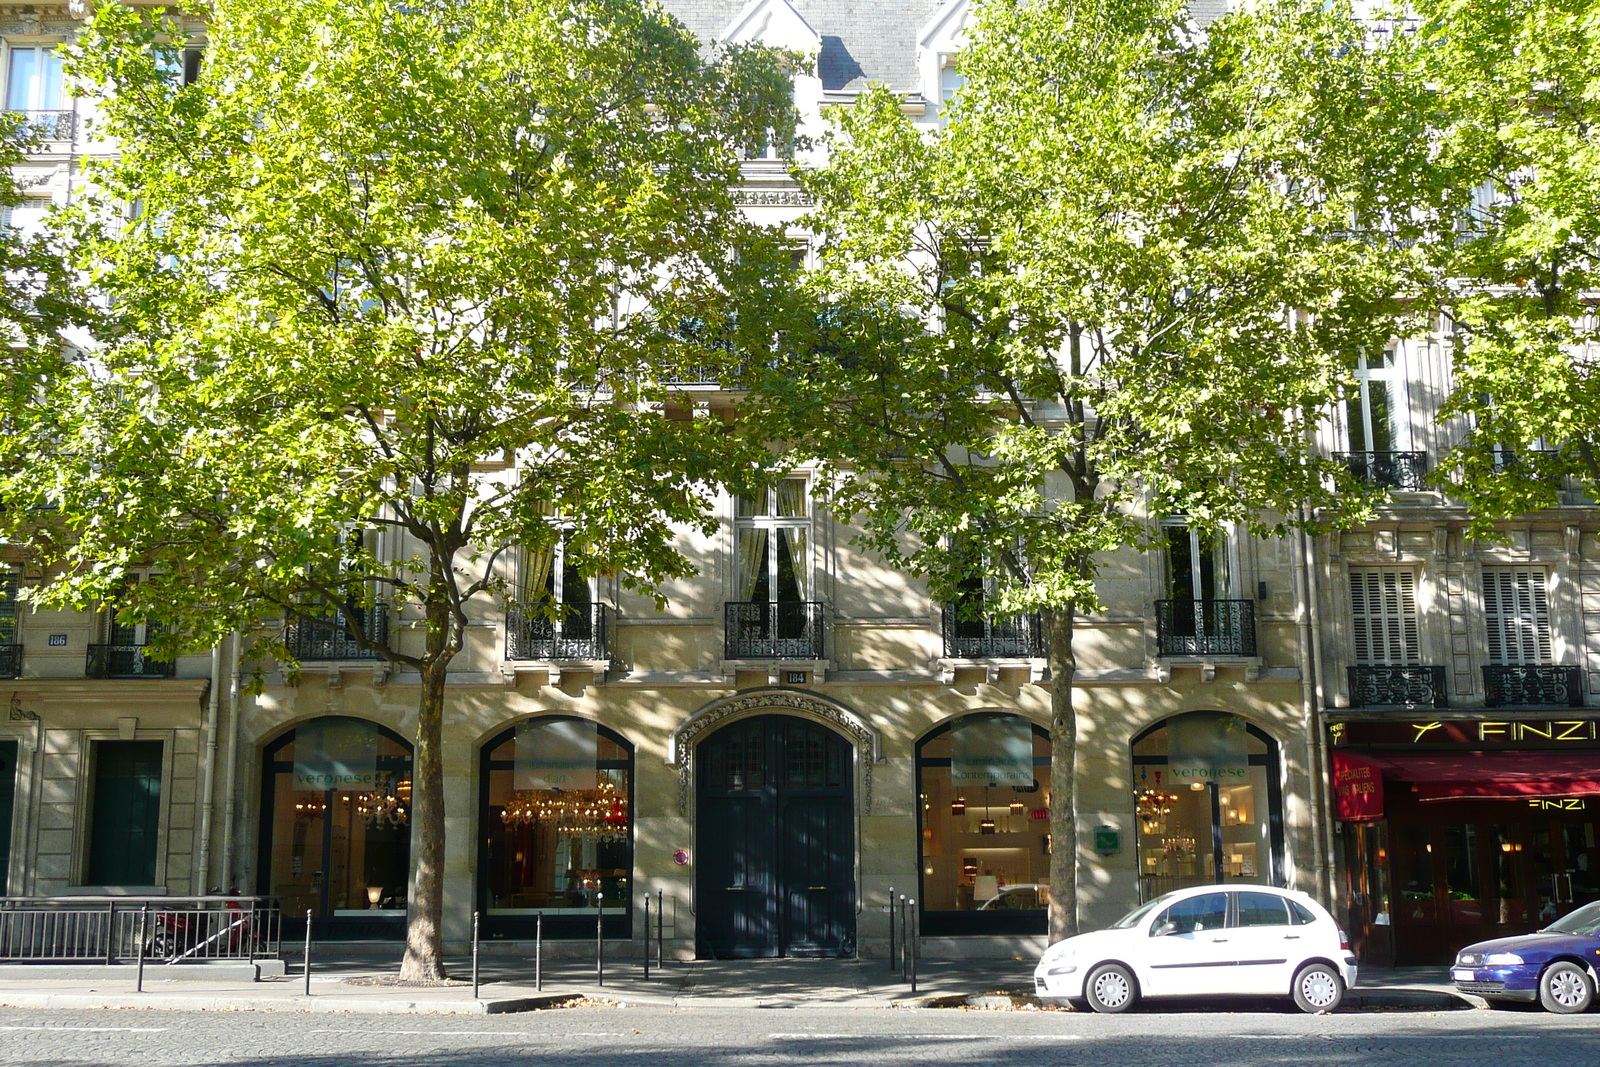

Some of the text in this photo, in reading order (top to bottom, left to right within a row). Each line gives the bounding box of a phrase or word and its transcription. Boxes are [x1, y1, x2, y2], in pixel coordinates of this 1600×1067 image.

[50, 635, 66, 646] 186
[789, 672, 805, 683] 184
[1479, 721, 1596, 741] FINZI
[955, 770, 1030, 780] contemporains
[1172, 767, 1246, 778] veronese
[297, 774, 372, 784] veronese
[1529, 799, 1586, 810] FINZI
